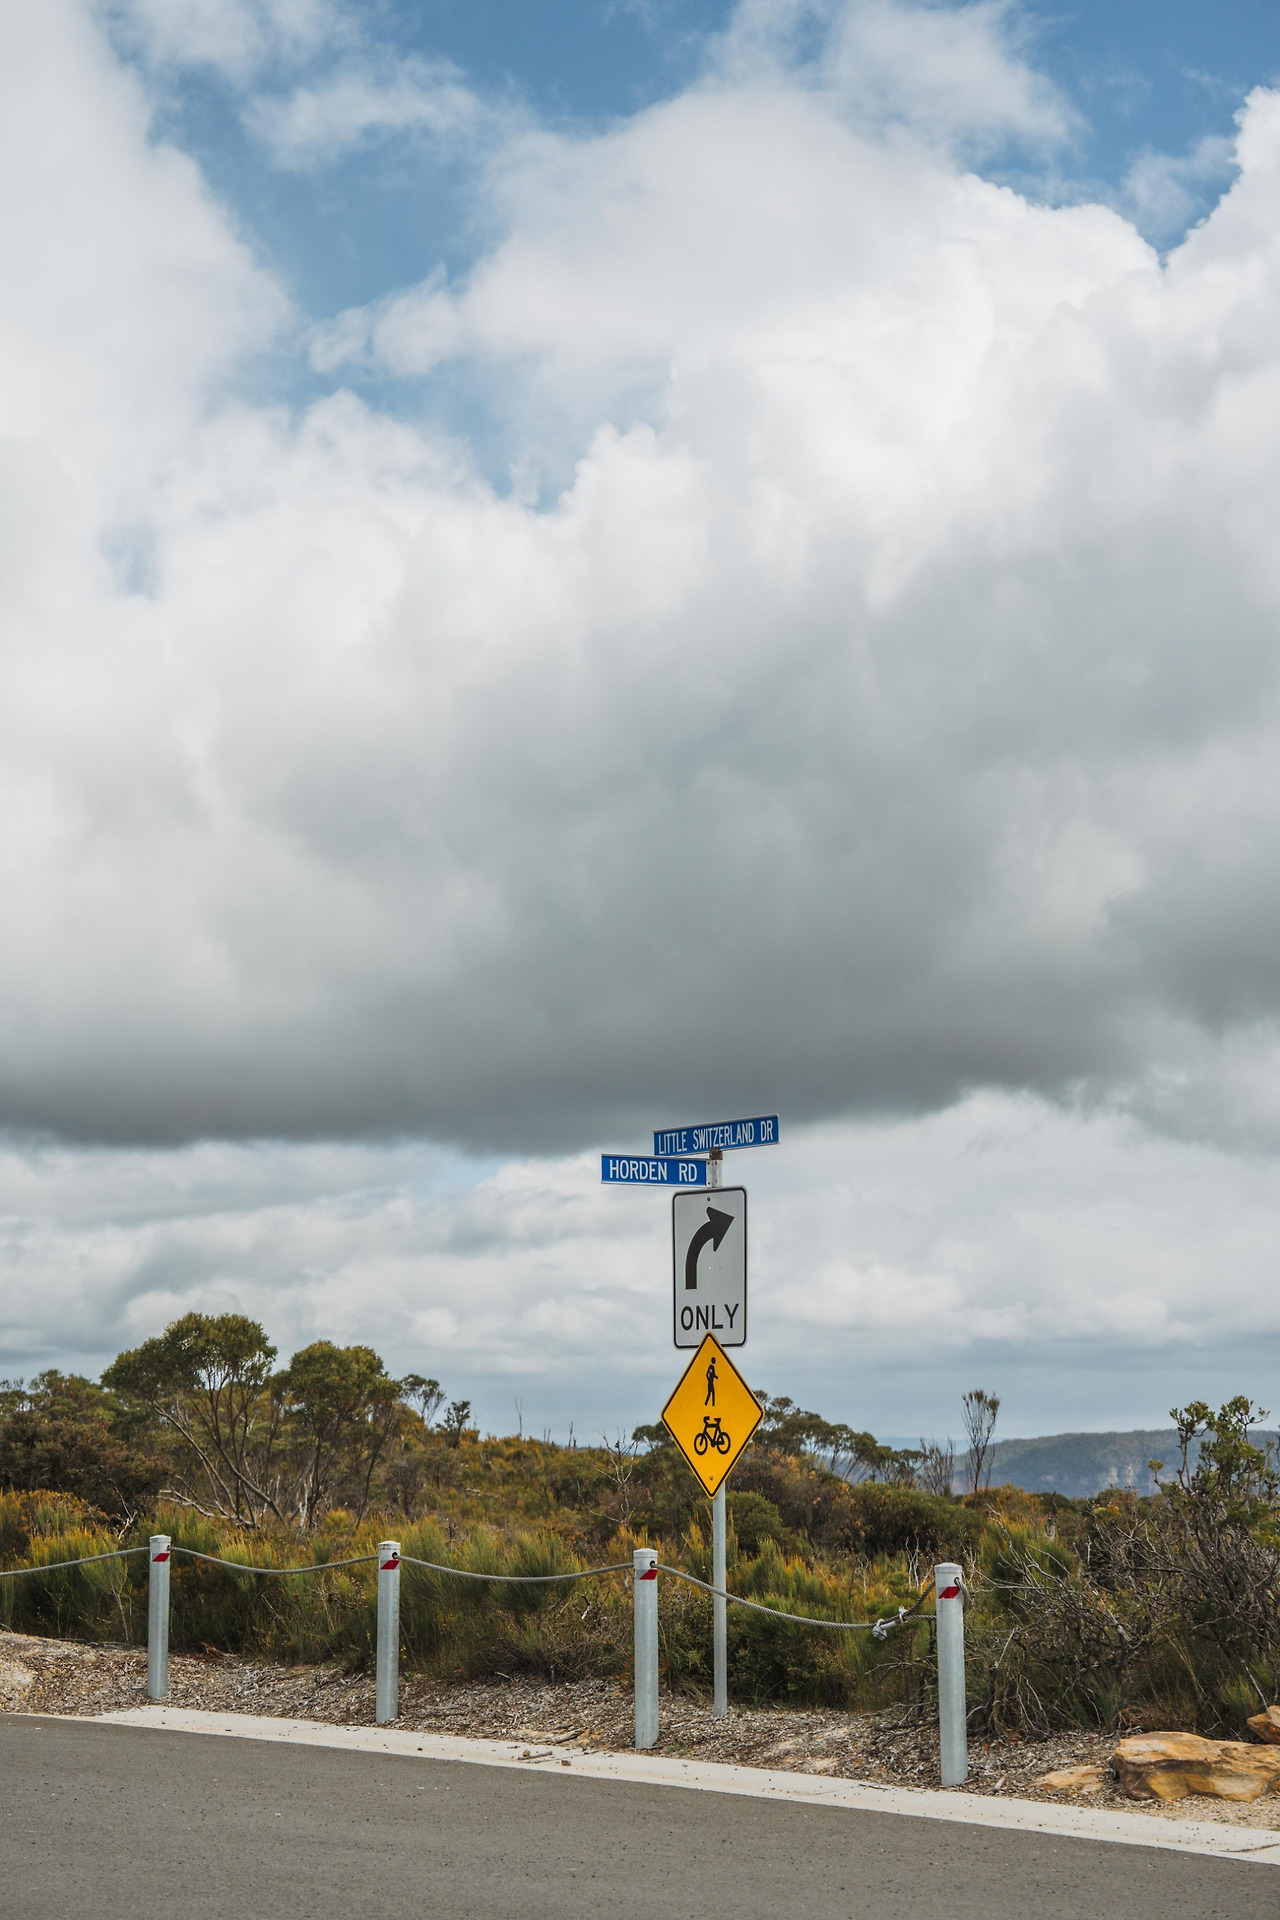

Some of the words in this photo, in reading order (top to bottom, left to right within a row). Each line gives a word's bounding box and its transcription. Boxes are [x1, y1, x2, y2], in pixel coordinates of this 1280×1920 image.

[658, 1131, 688, 1155] LITTLE
[692, 1122, 755, 1150] SWITZERLAND
[760, 1119, 774, 1141] DR
[609, 1159, 668, 1181] HORDEN
[678, 1162, 698, 1182] RD
[680, 1303, 740, 1331] ONLY
